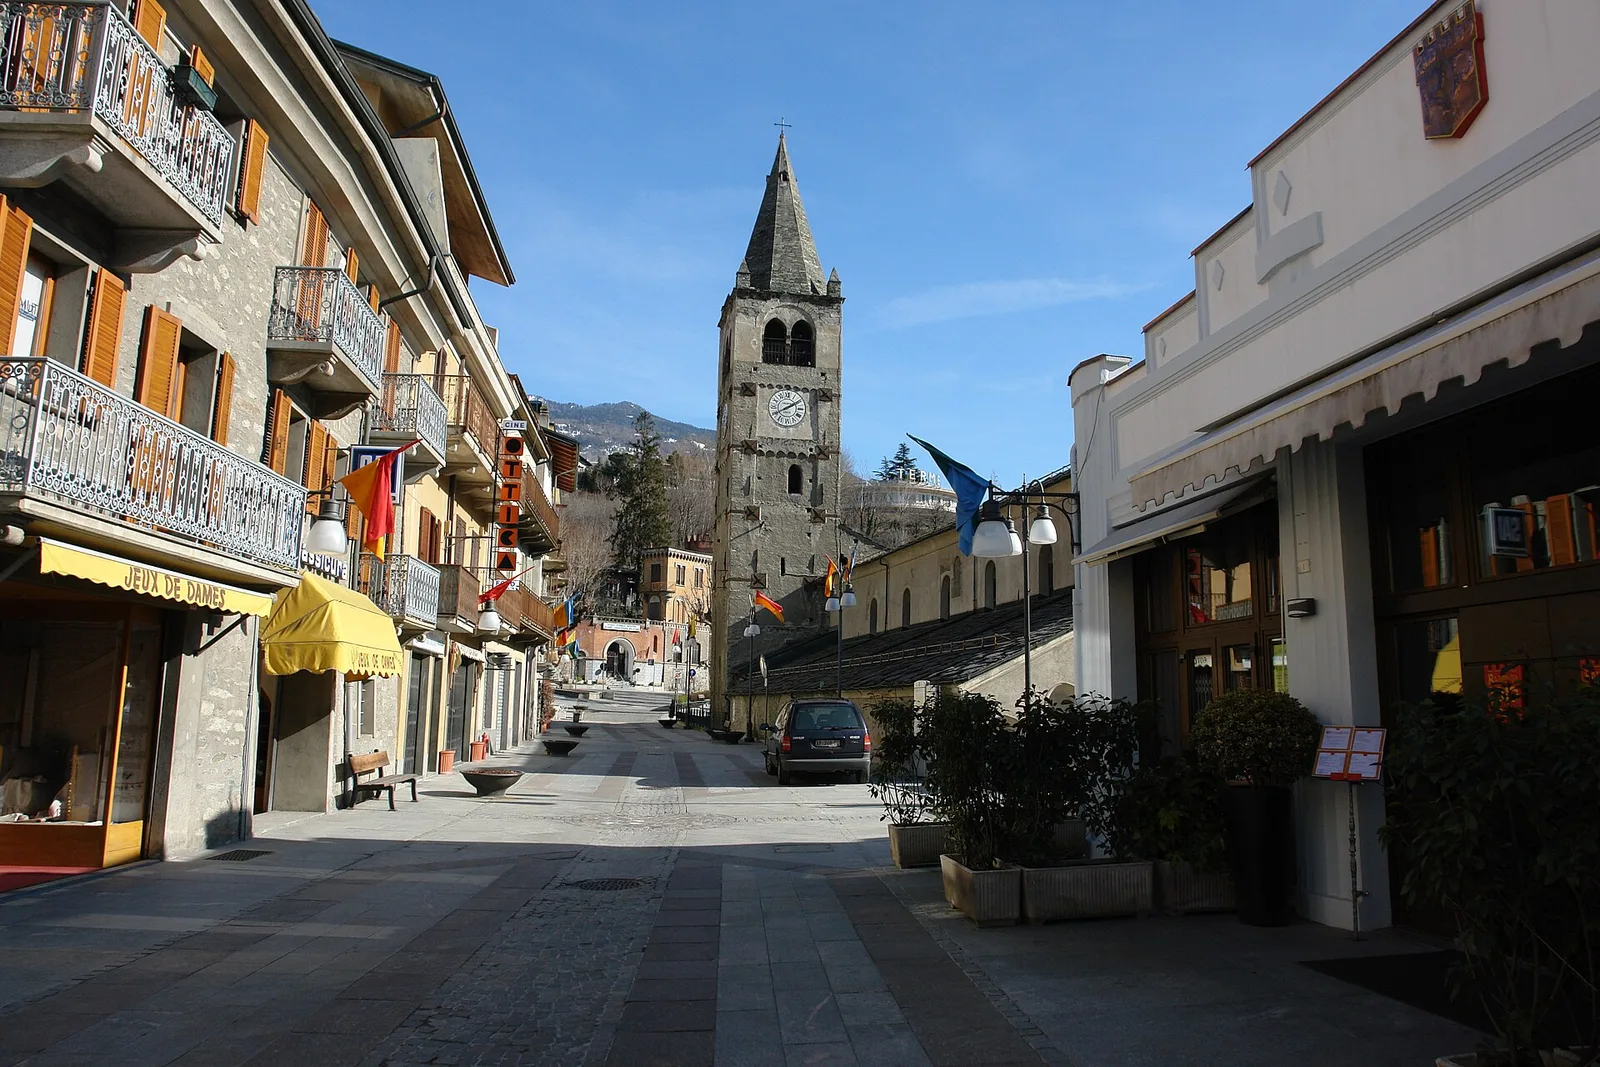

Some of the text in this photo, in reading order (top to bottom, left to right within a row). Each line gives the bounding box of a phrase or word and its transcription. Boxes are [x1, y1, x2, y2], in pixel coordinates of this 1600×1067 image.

[497, 438, 521, 569] OTTICA
[124, 566, 226, 608] JEUX DE DAMES
